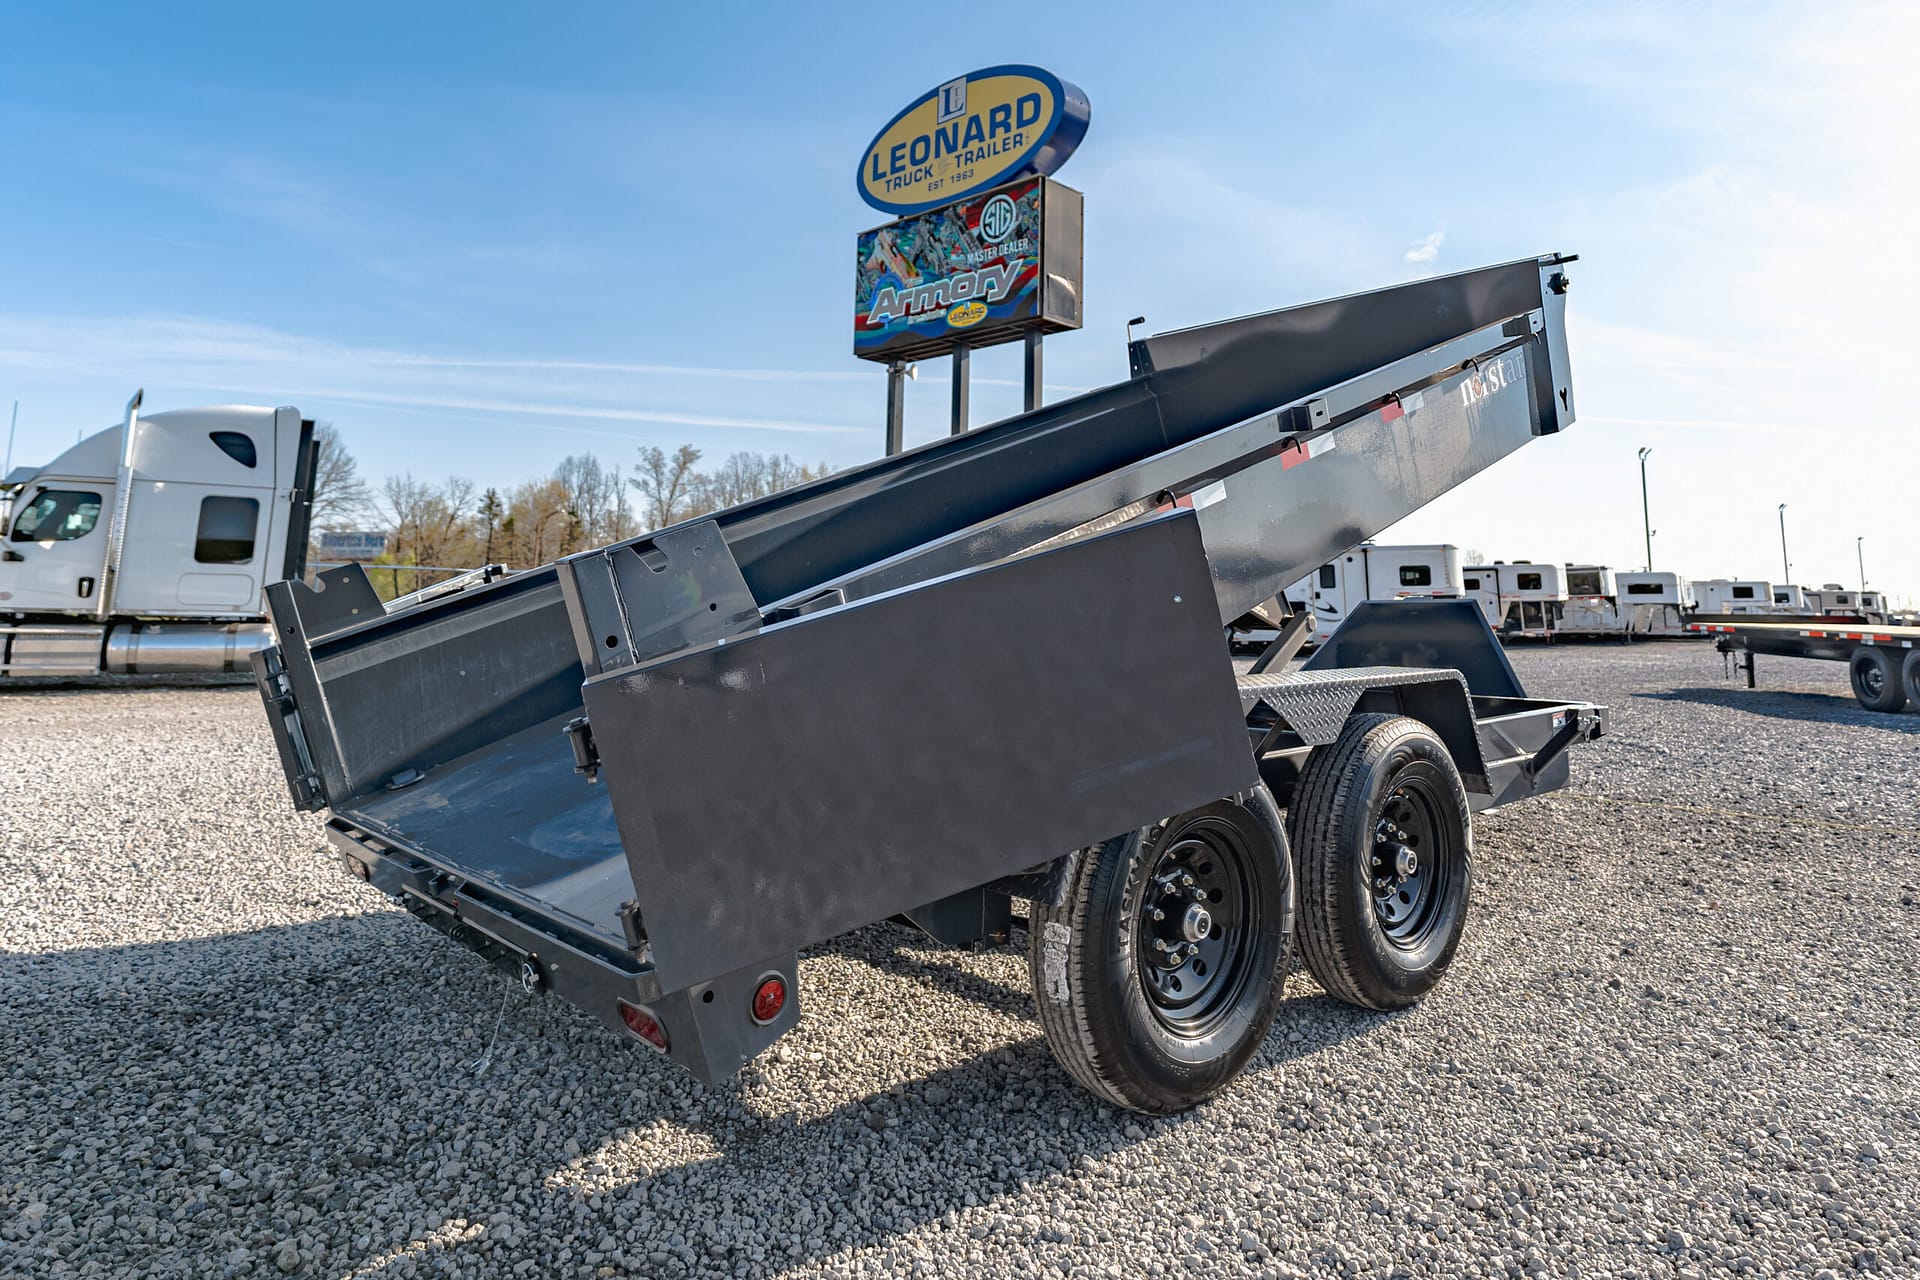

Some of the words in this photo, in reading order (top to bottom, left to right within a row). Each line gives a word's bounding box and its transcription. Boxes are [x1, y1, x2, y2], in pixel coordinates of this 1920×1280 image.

[872, 92, 1041, 182] LEONARD
[885, 164, 933, 193] TRUCK
[954, 133, 1023, 168] TRAILER
[928, 178, 944, 192] EST
[950, 168, 975, 184] 1963
[985, 200, 1011, 236] SIG
[967, 246, 998, 264] MASTER
[999, 237, 1029, 255] DEALER
[866, 259, 1023, 325] Armory
